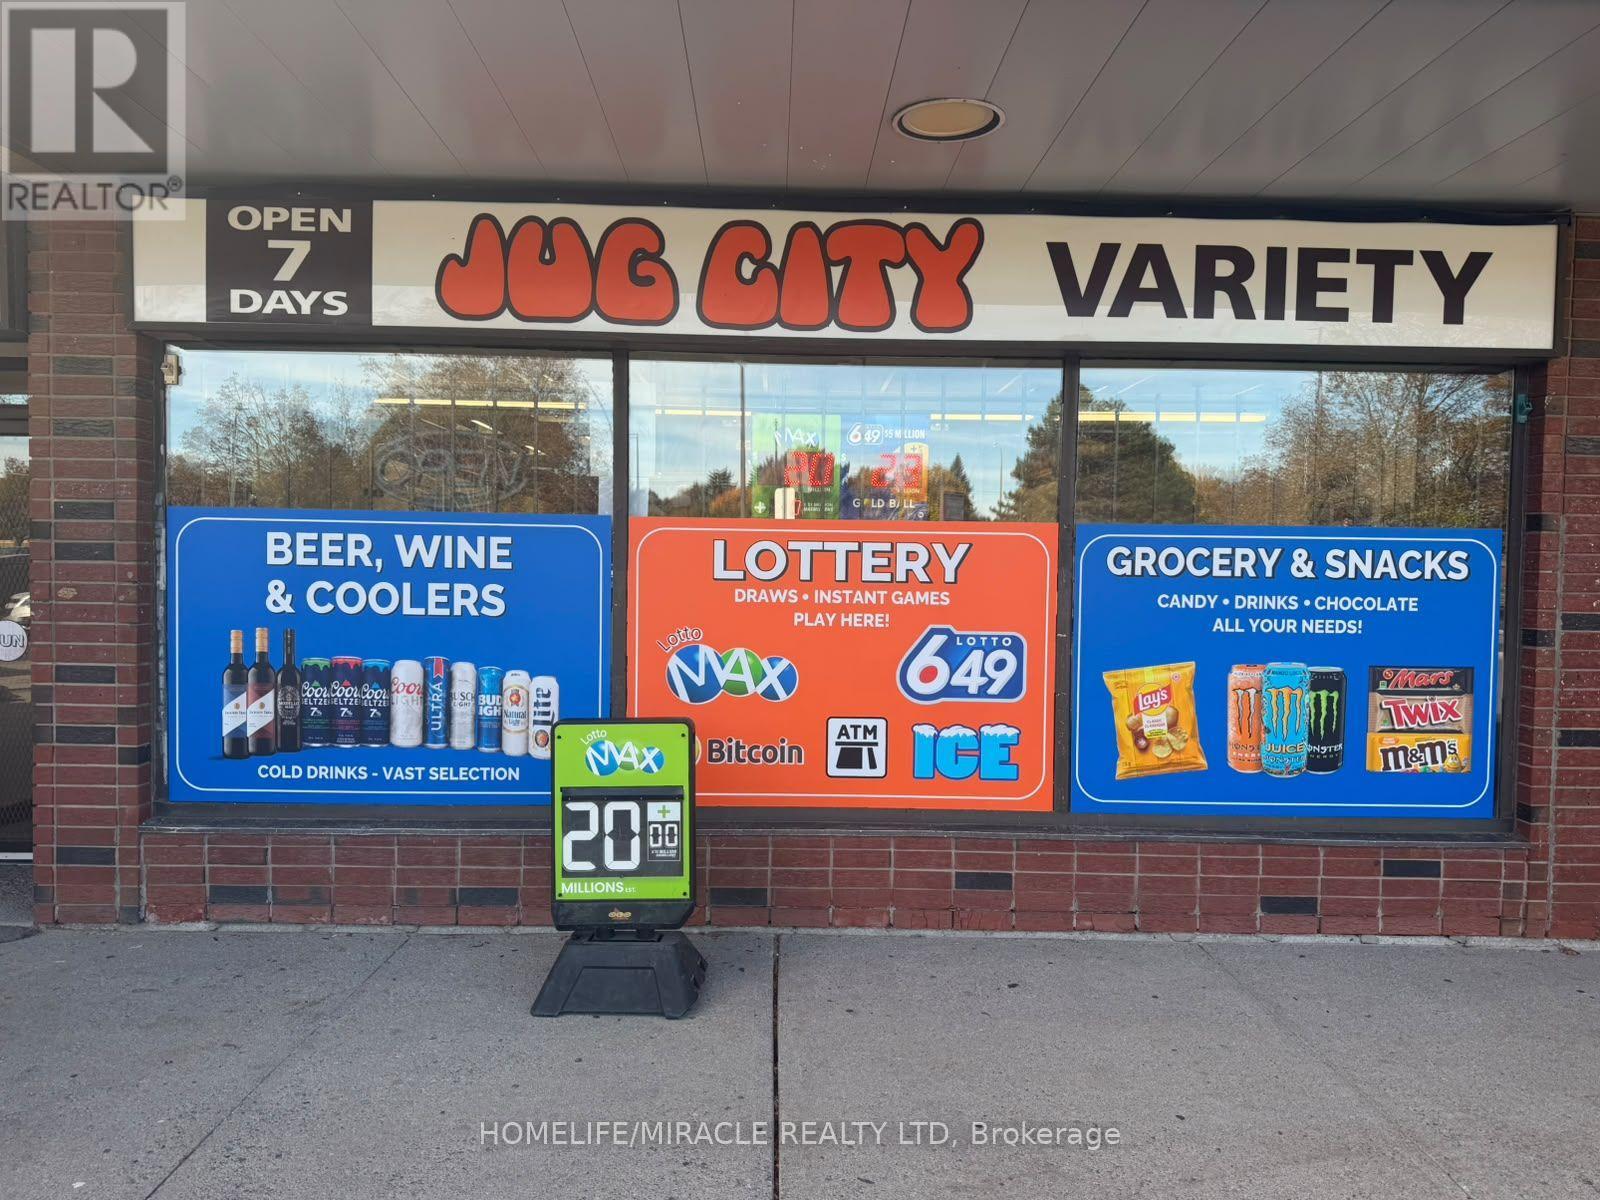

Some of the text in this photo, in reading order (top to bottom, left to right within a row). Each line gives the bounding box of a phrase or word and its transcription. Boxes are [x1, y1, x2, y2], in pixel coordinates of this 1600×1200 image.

[227, 205, 352, 233] OPEN
[267, 239, 312, 282] 7
[435, 212, 984, 334] JUG CITY
[1046, 241, 1494, 326] VARIETY
[229, 289, 349, 316] DAYS
[895, 429, 926, 439] MLLION
[784, 451, 834, 488] 20
[265, 531, 514, 573] BEER, WINE
[712, 539, 973, 585] LOTTERY
[1106, 546, 1471, 581] GROCERY & SNACKS
[265, 579, 507, 617] & COOLERS
[733, 588, 950, 606] DRAWS INSTANT GAMES
[1157, 594, 1419, 612] CANDY DRINKS CHOCOLATE
[793, 612, 890, 629] PLAY HERE!
[1212, 618, 1363, 635] ALL YOUR NEEDS!
[656, 627, 703, 652] Lotto
[955, 636, 1013, 647] LOTTO
[667, 647, 794, 703] MAX
[1388, 669, 1455, 690] Mars
[431, 681, 443, 731] ULTRA
[478, 705, 502, 717] IGH
[1138, 688, 1169, 711] Lay's
[503, 709, 528, 720] Natural
[1382, 697, 1463, 730] Twix
[580, 728, 608, 745] Lotto
[836, 724, 878, 740] ATM
[585, 739, 662, 776] MAX
[706, 738, 803, 765] Bitcoin
[911, 723, 1021, 781] ICE
[1265, 742, 1305, 755] JUICE
[1306, 743, 1343, 754] ONSTER
[257, 764, 303, 779] COLD
[307, 765, 369, 780] DRINKS
[382, 766, 426, 781] VAST
[428, 766, 520, 782] SELECTION
[562, 800, 641, 872] 20
[561, 881, 624, 895] MILLIONS
